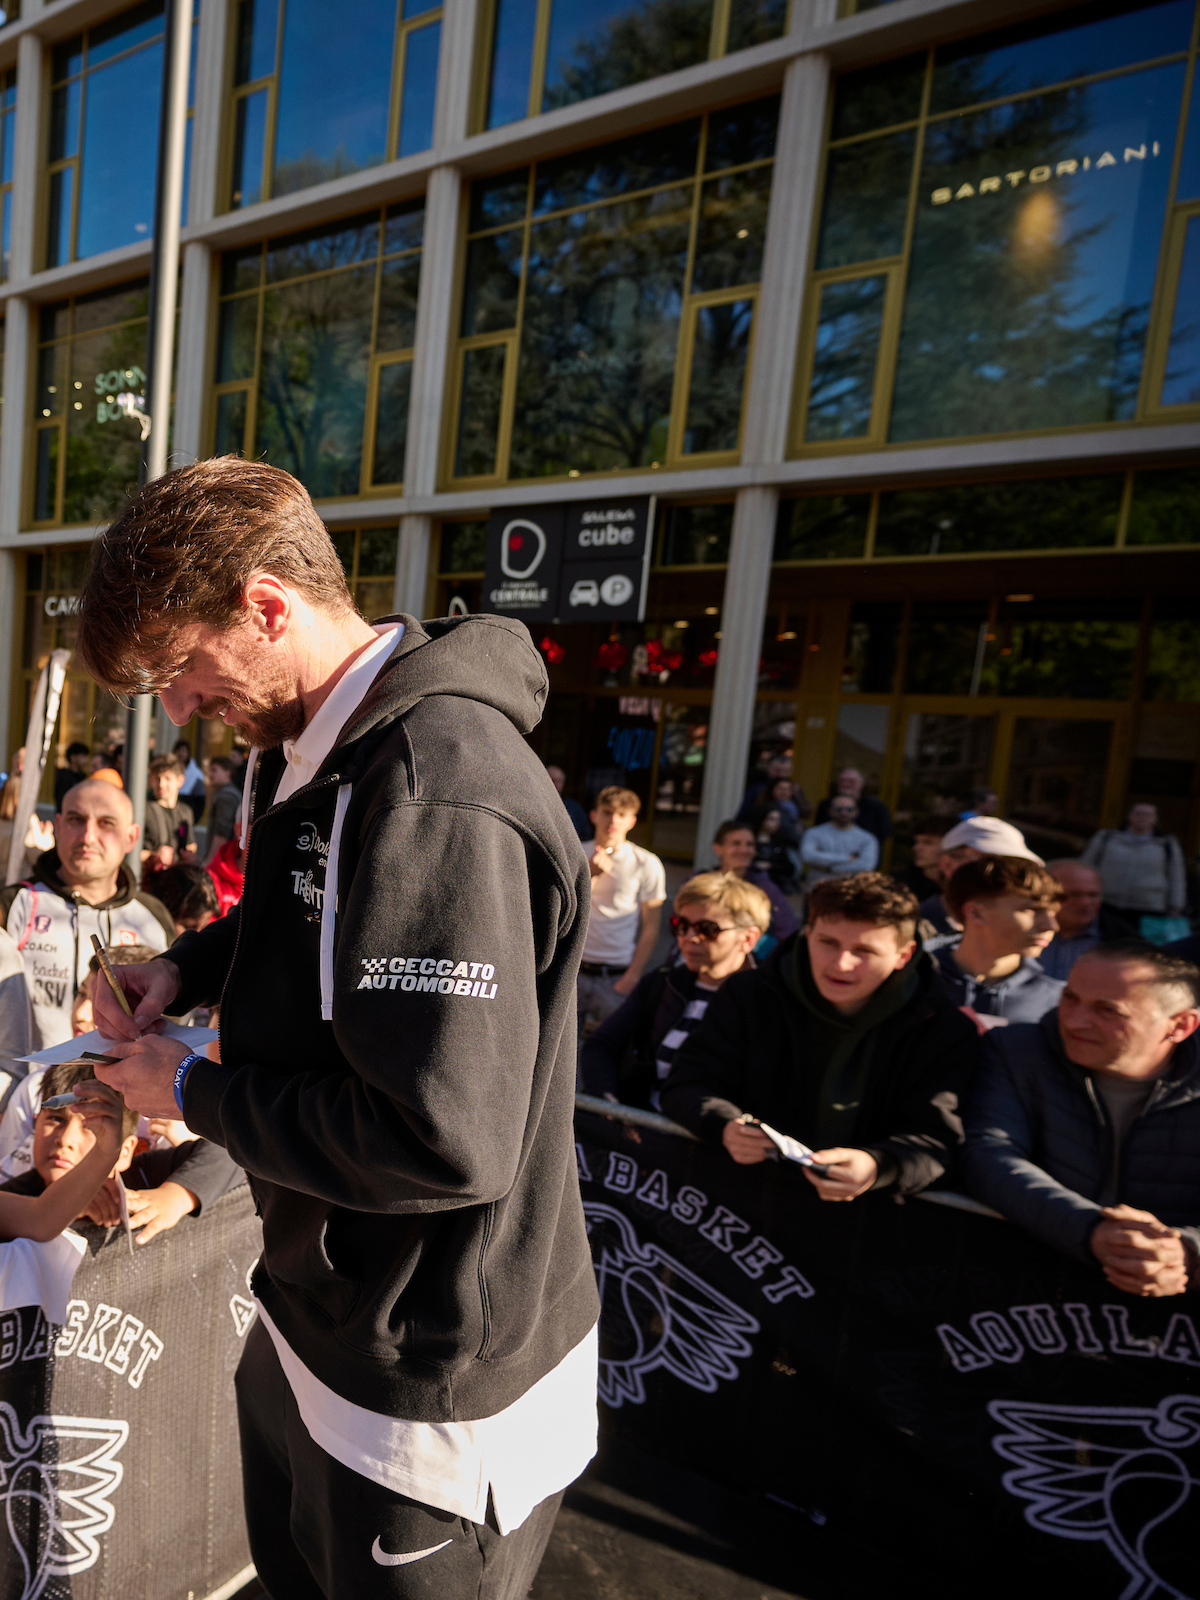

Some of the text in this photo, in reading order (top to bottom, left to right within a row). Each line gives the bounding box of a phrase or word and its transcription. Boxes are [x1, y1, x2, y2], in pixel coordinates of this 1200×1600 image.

[931, 140, 1160, 206] SARTORIANI
[94, 366, 147, 395] SONN
[578, 523, 635, 547] cube
[490, 587, 549, 603] CENTRALE
[24, 941, 58, 953] COACH
[33, 961, 69, 980] basket
[388, 957, 495, 981] CECCATO
[356, 974, 499, 1000] AUTOMOBILI
[173, 1053, 197, 1089] LUE DAY
[604, 1150, 816, 1304] BASKET
[936, 1302, 1200, 1373] AQUILA
